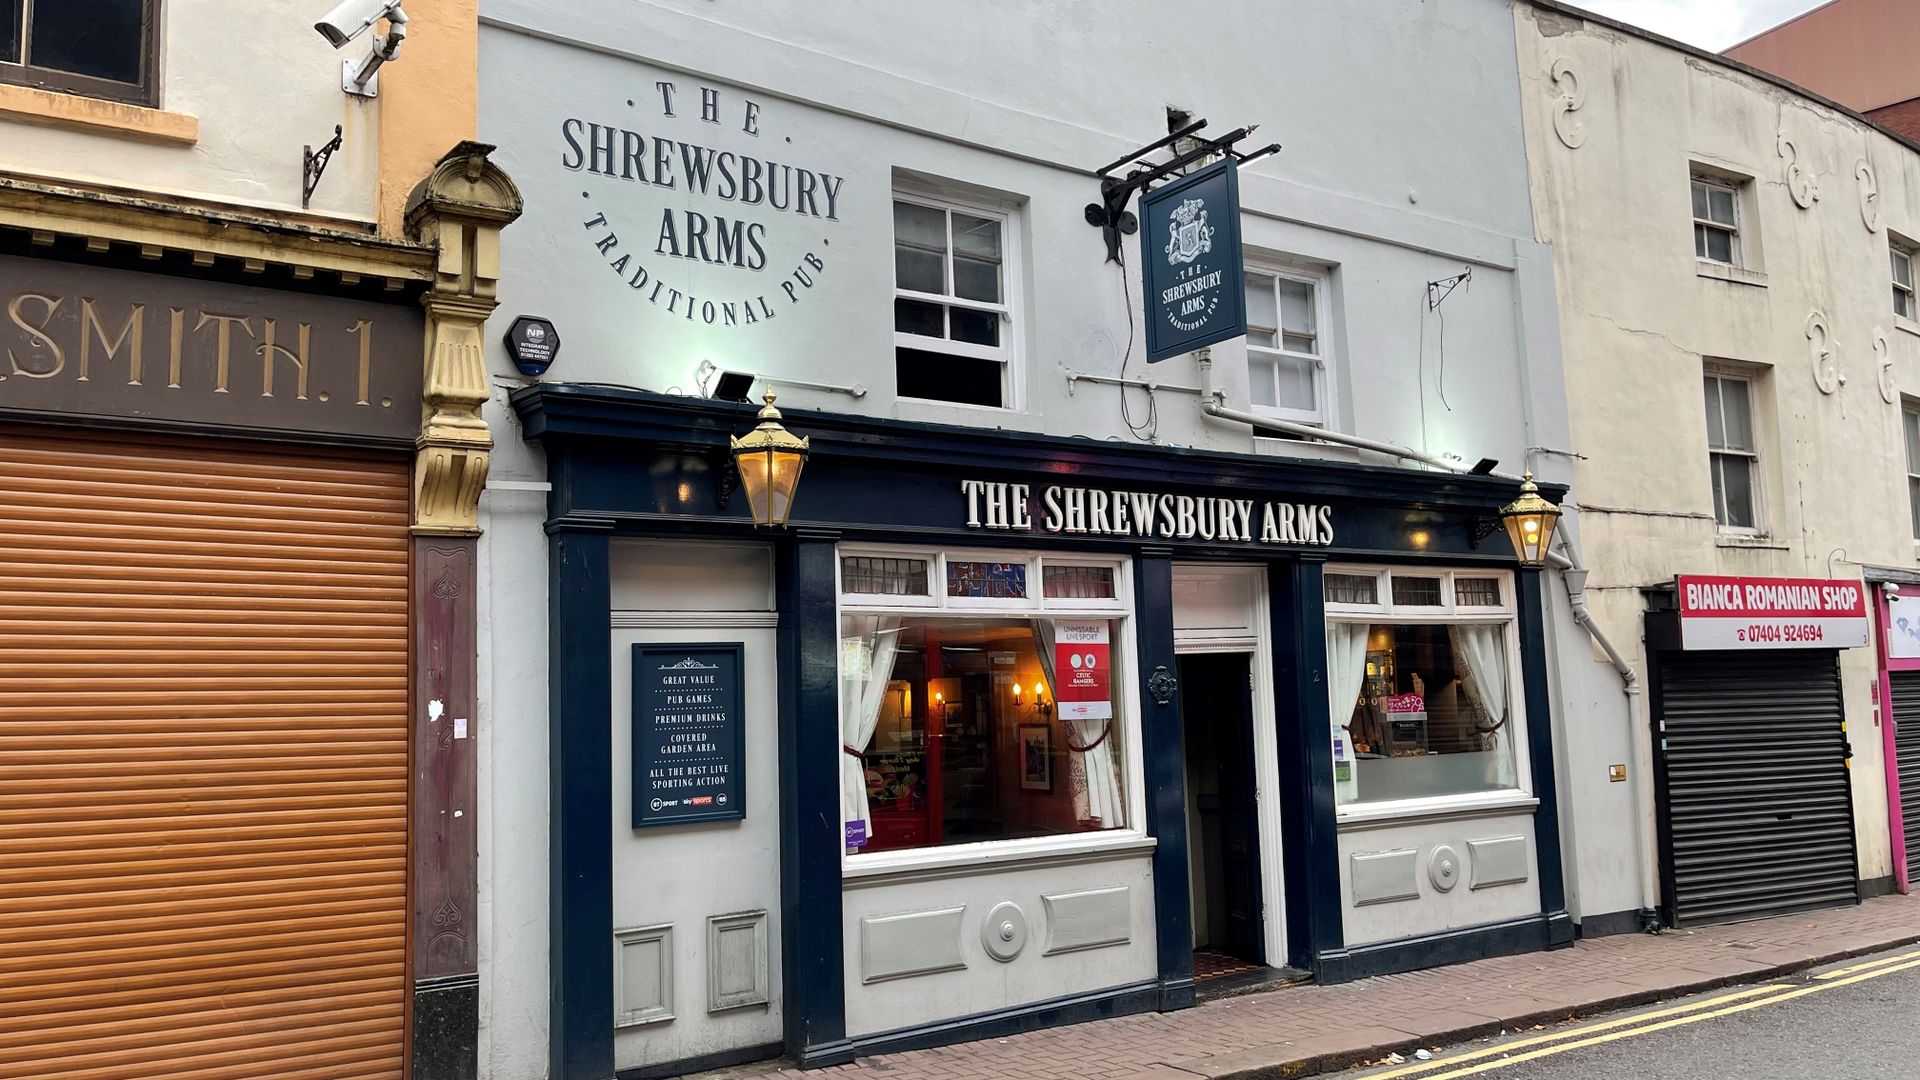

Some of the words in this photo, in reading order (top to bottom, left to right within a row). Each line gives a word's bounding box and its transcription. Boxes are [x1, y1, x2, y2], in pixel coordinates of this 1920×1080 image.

[655, 81, 761, 136] THE
[562, 118, 844, 221] SHREWSBURY
[654, 208, 767, 272] ARMS
[583, 211, 777, 327] TRADITIONAL
[781, 251, 825, 304] PUB
[1180, 264, 1201, 280] THE
[1162, 269, 1222, 304] SHREWSBURY
[1180, 294, 1206, 316] ARMS
[1167, 311, 1208, 331] TRADITIONAL
[1207, 297, 1218, 315] PUB
[527, 328, 545, 337] NP
[520, 342, 550, 350] INTEGRATED
[520, 347, 550, 355] TECHNOLOGY
[961, 479, 1032, 530] THE
[1044, 485, 1254, 542] SHREWSBURY
[1259, 501, 1334, 546] ARMS
[1686, 583, 1744, 611] BIANCA
[1745, 584, 1821, 611] ROMANIAN
[1822, 585, 1858, 611] SHOP
[1063, 625, 1101, 633] UNMISSABLE
[1066, 632, 1080, 640] LIVE
[1748, 624, 1781, 642] 07404
[1784, 624, 1823, 642] 924694
[663, 675, 687, 685] GREAT
[690, 675, 715, 684] VALUE
[667, 695, 683, 704] PUB
[686, 694, 713, 704] GAMES
[655, 714, 693, 724] PREMIUM
[696, 712, 726, 723] DRINKS
[670, 732, 707, 743] COVERED
[661, 744, 693, 754] GARDEN
[696, 743, 716, 753] AREA
[649, 768, 665, 778] ALL
[668, 767, 684, 777] THE
[687, 766, 707, 775] BEST
[710, 764, 729, 774] LIVE
[652, 778, 693, 789] SPORTING
[696, 775, 726, 786] ACTION
[662, 800, 679, 808] SPORT
